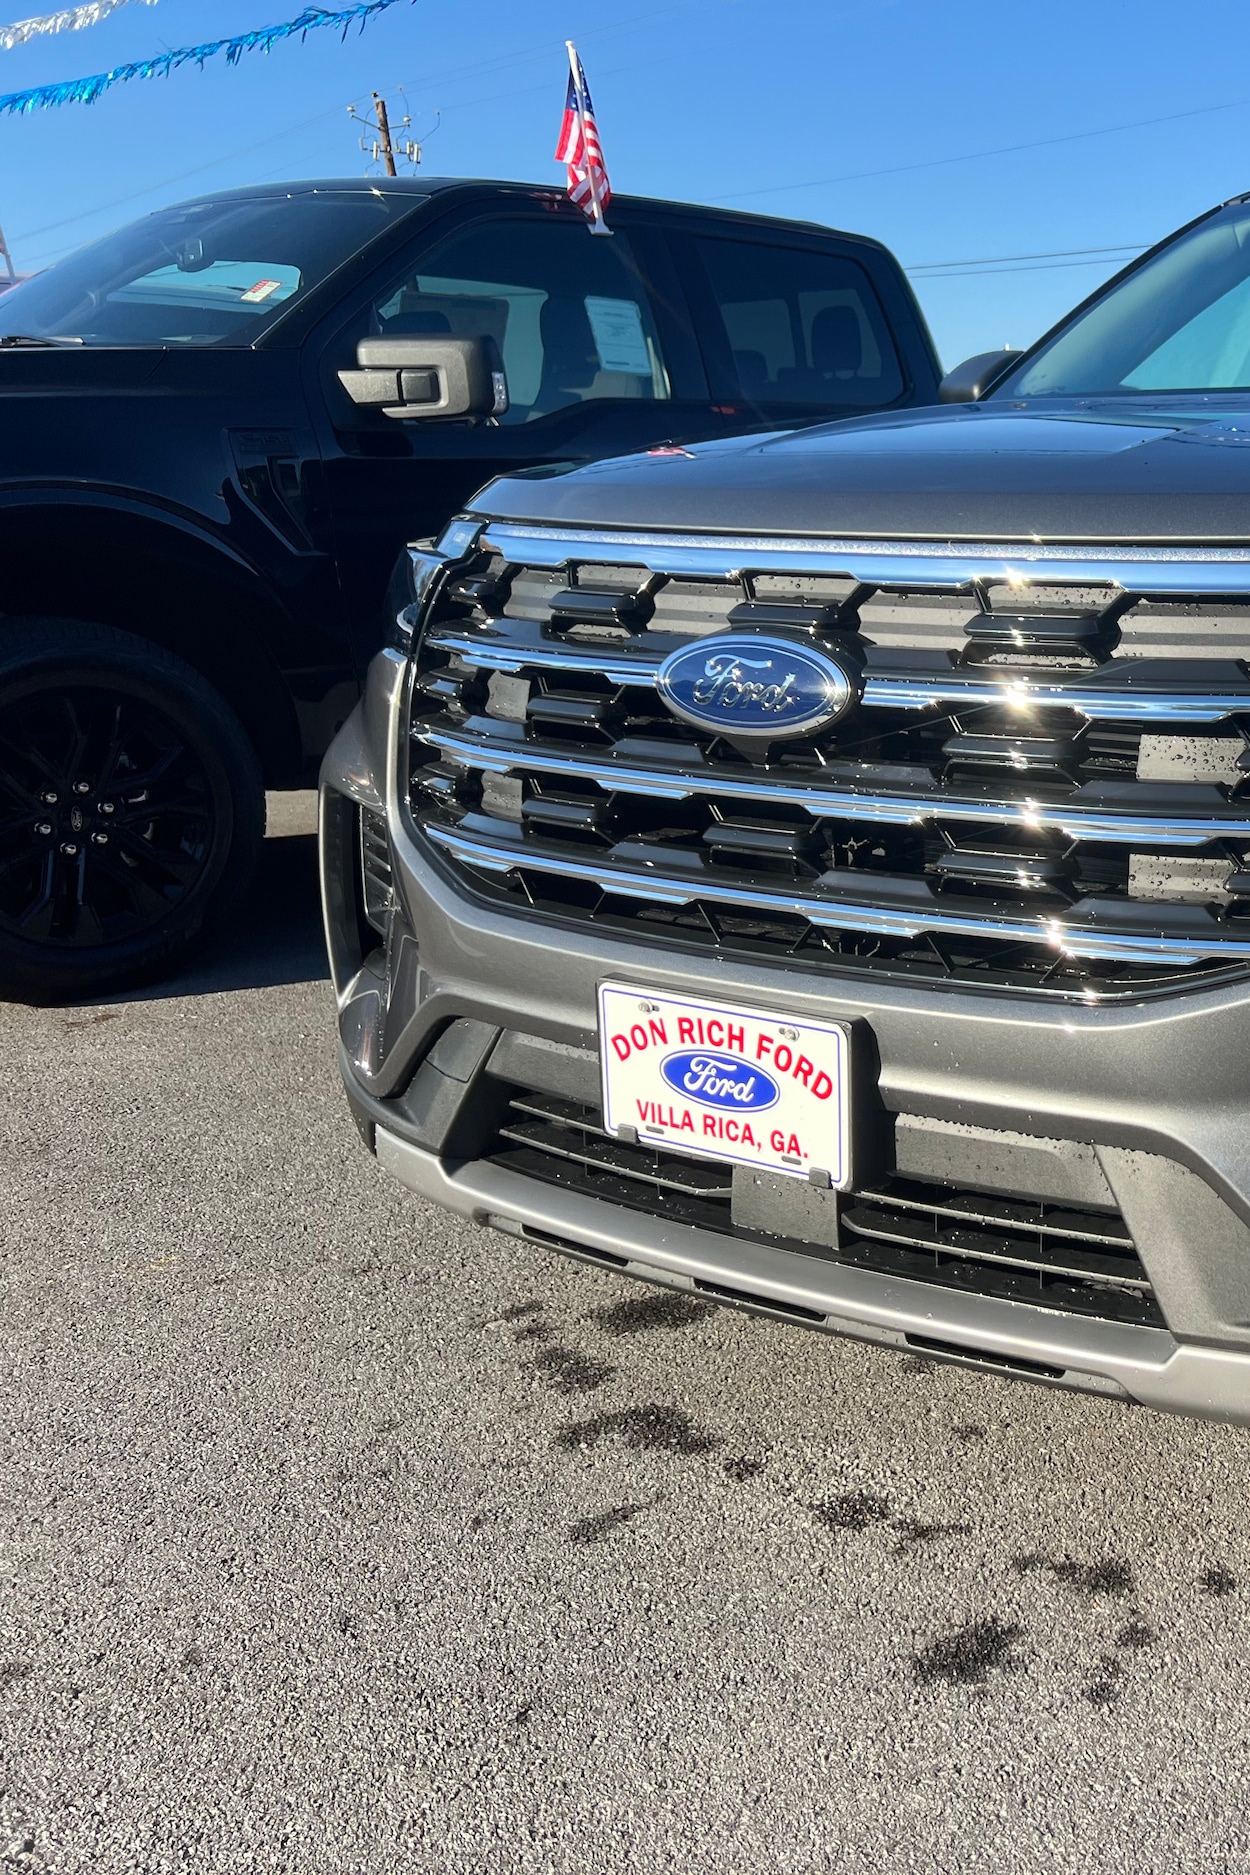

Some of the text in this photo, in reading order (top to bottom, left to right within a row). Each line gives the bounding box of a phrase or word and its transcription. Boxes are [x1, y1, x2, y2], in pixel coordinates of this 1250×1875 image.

[693, 653, 797, 712] Ford
[611, 1016, 833, 1100] DON RICH FORD
[683, 1056, 756, 1103] Ford
[636, 1099, 809, 1159] VILLA RICA, GA.
